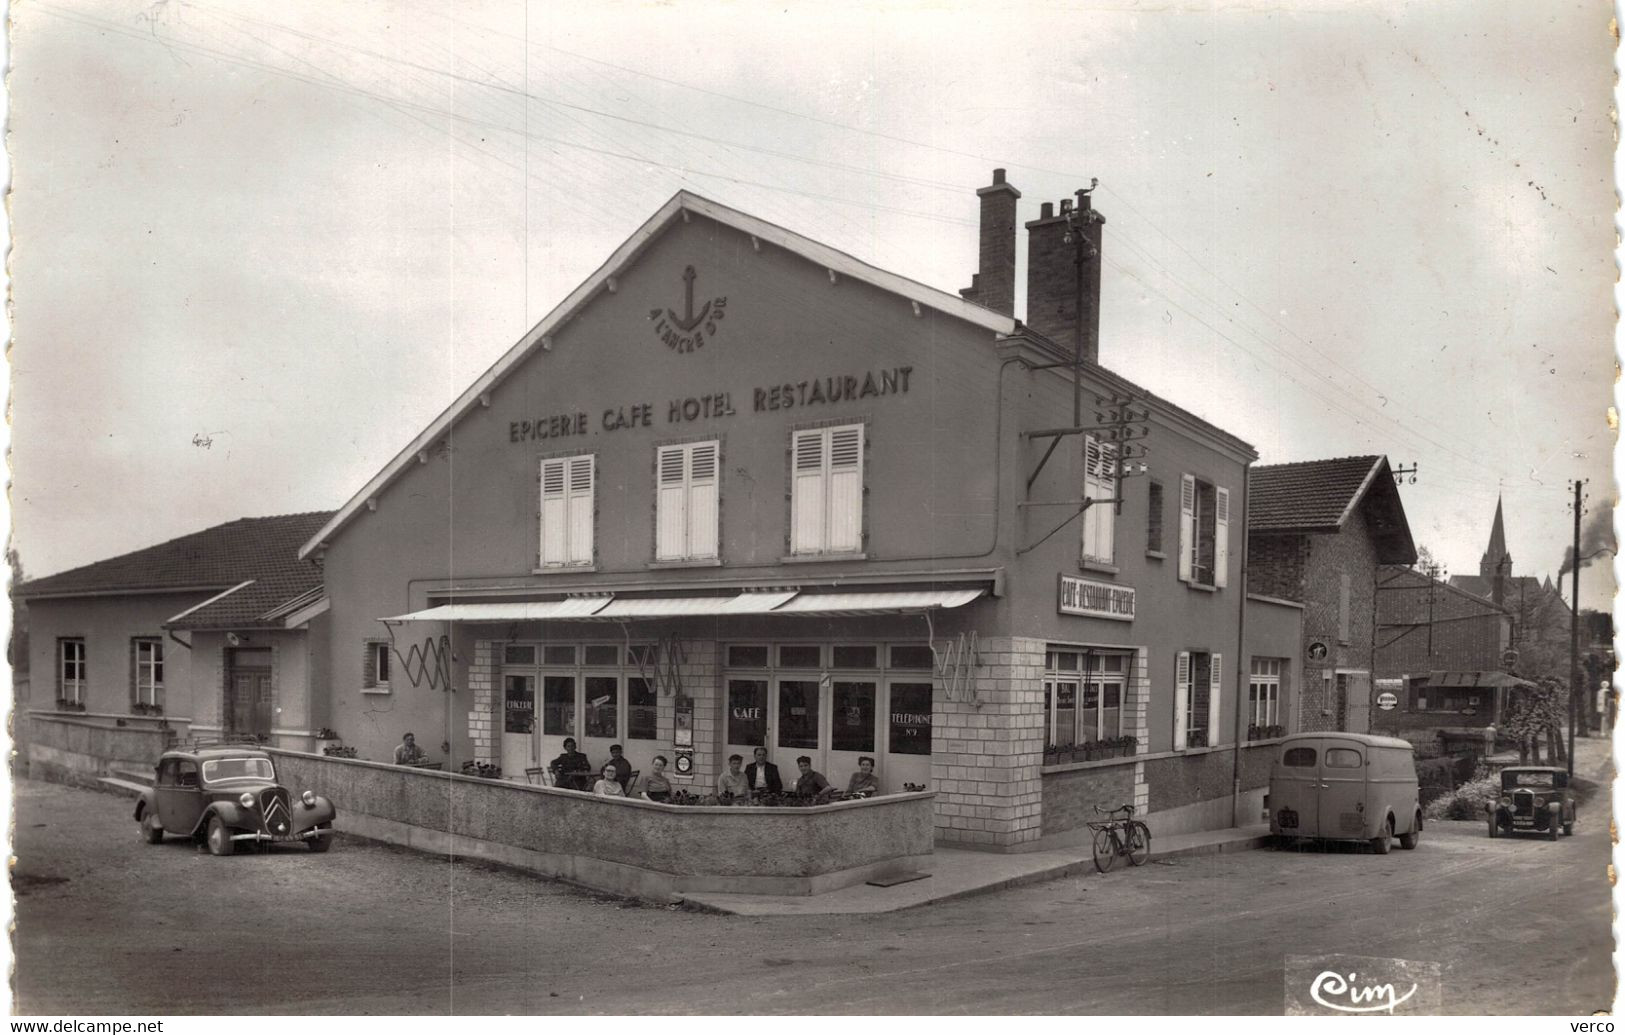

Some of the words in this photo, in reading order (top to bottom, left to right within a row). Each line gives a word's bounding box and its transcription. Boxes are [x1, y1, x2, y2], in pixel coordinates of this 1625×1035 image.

[650, 308, 663, 321] A
[705, 296, 728, 337] D'OR
[655, 318, 705, 354] L'ANCRE
[509, 412, 589, 443] EPICERIE
[602, 403, 653, 432] CAFE
[667, 392, 736, 424] HOTEL
[753, 365, 914, 412] RESTAURANT
